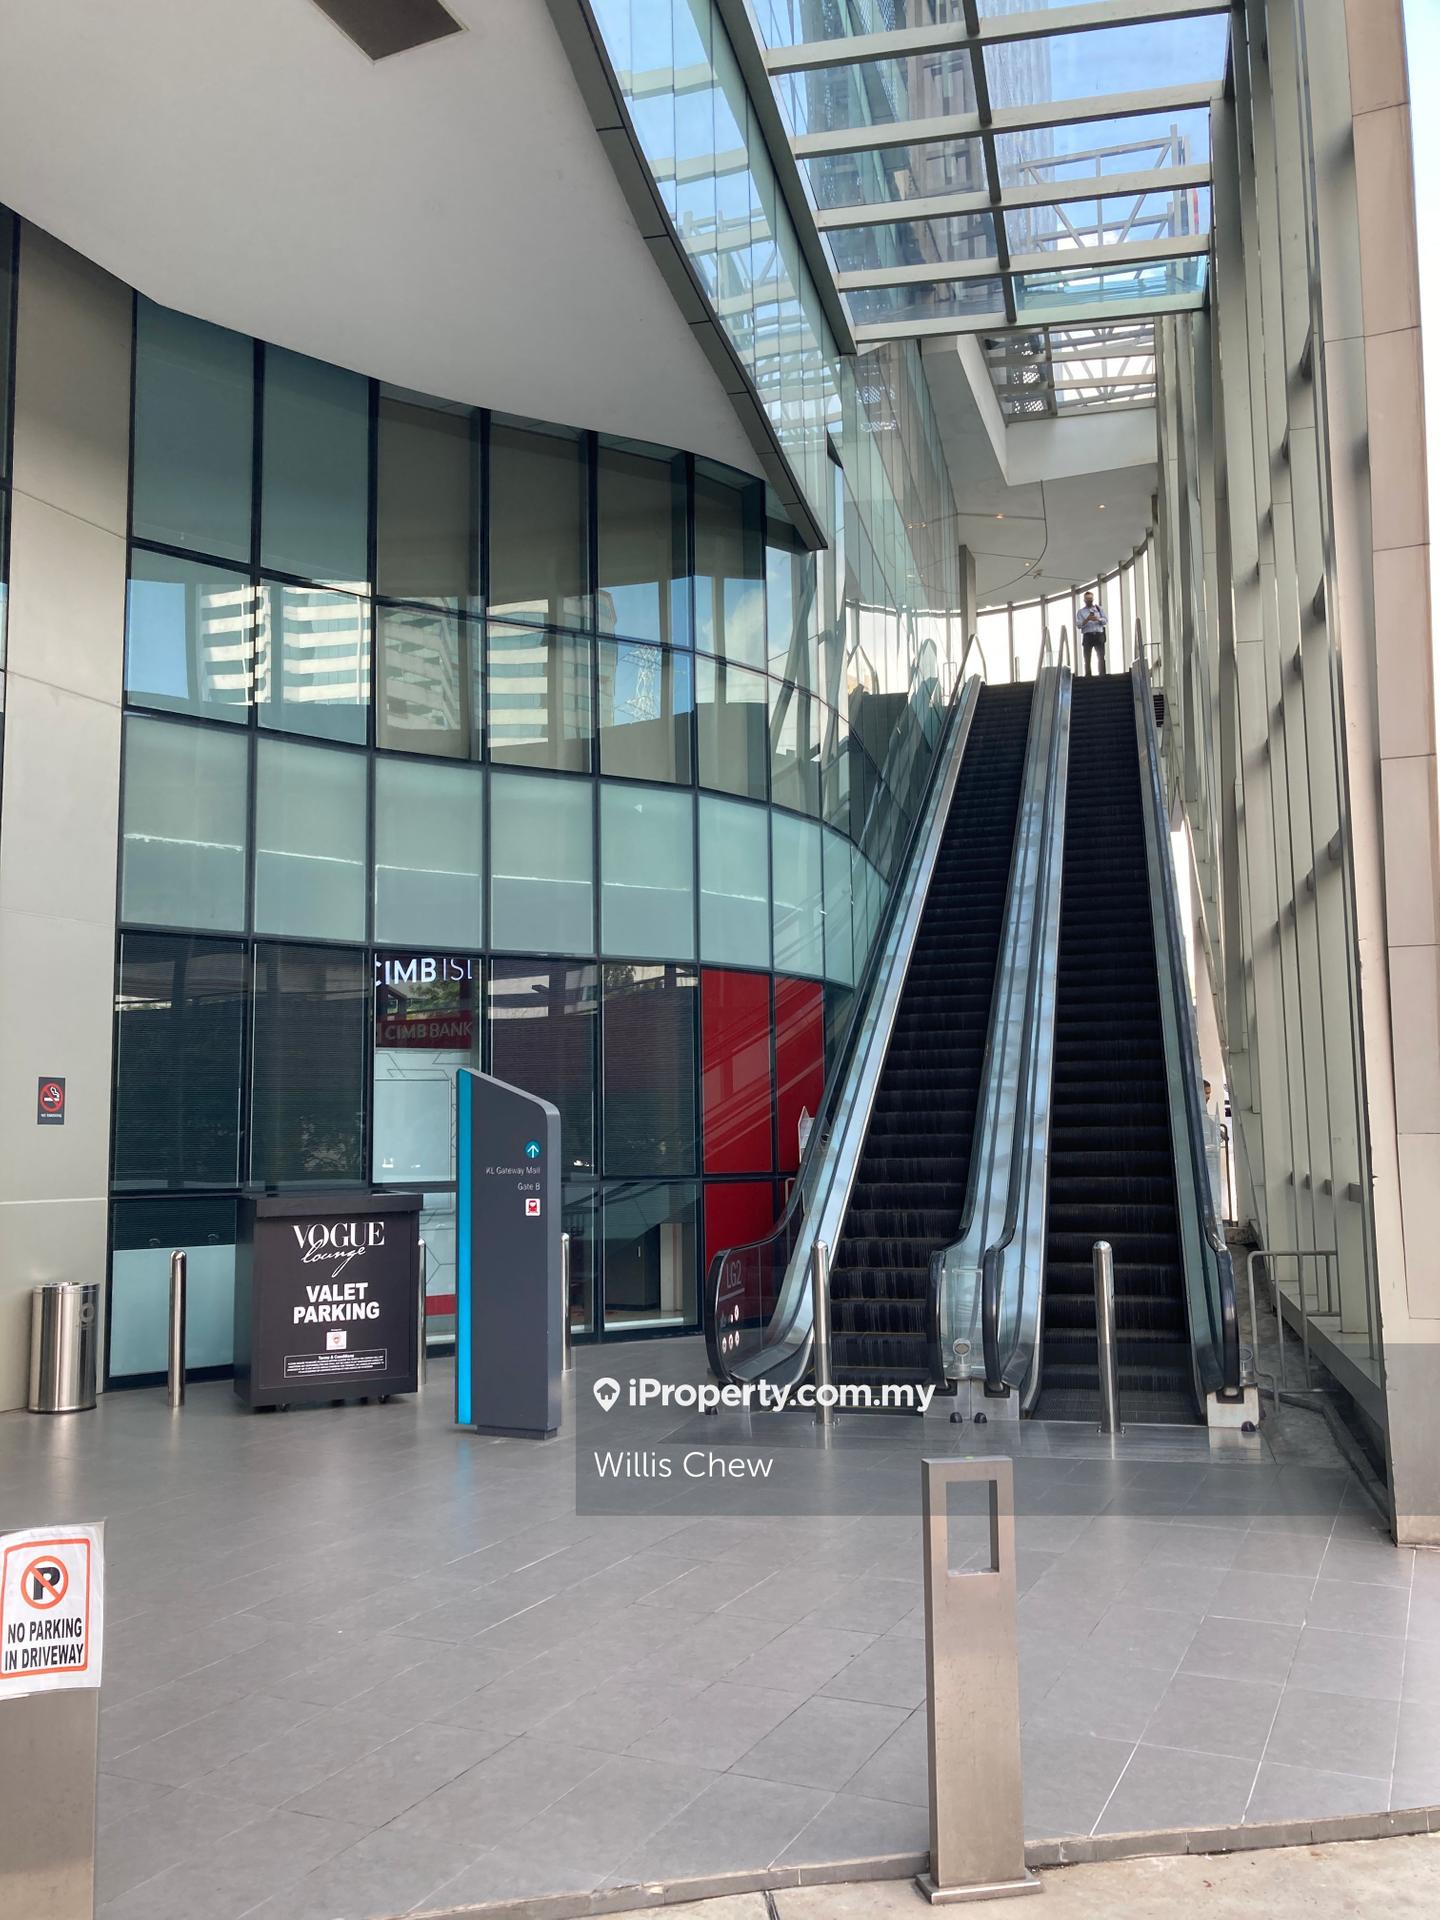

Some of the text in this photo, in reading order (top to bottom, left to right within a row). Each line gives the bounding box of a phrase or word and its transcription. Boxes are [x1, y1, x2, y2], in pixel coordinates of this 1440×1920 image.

[384, 1020, 473, 1040] CIMB BANK
[486, 1166, 541, 1176] KL Gateway Mall
[517, 1182, 541, 1190] Gate B
[291, 1221, 385, 1249] VOGUE
[301, 1239, 367, 1278] lounge
[726, 1260, 742, 1288] LG2
[306, 1282, 369, 1302] VALET
[293, 1302, 380, 1325] PARKING
[8, 1617, 82, 1645] NO PARKING
[5, 1643, 84, 1671] IN DRIVEWAY
